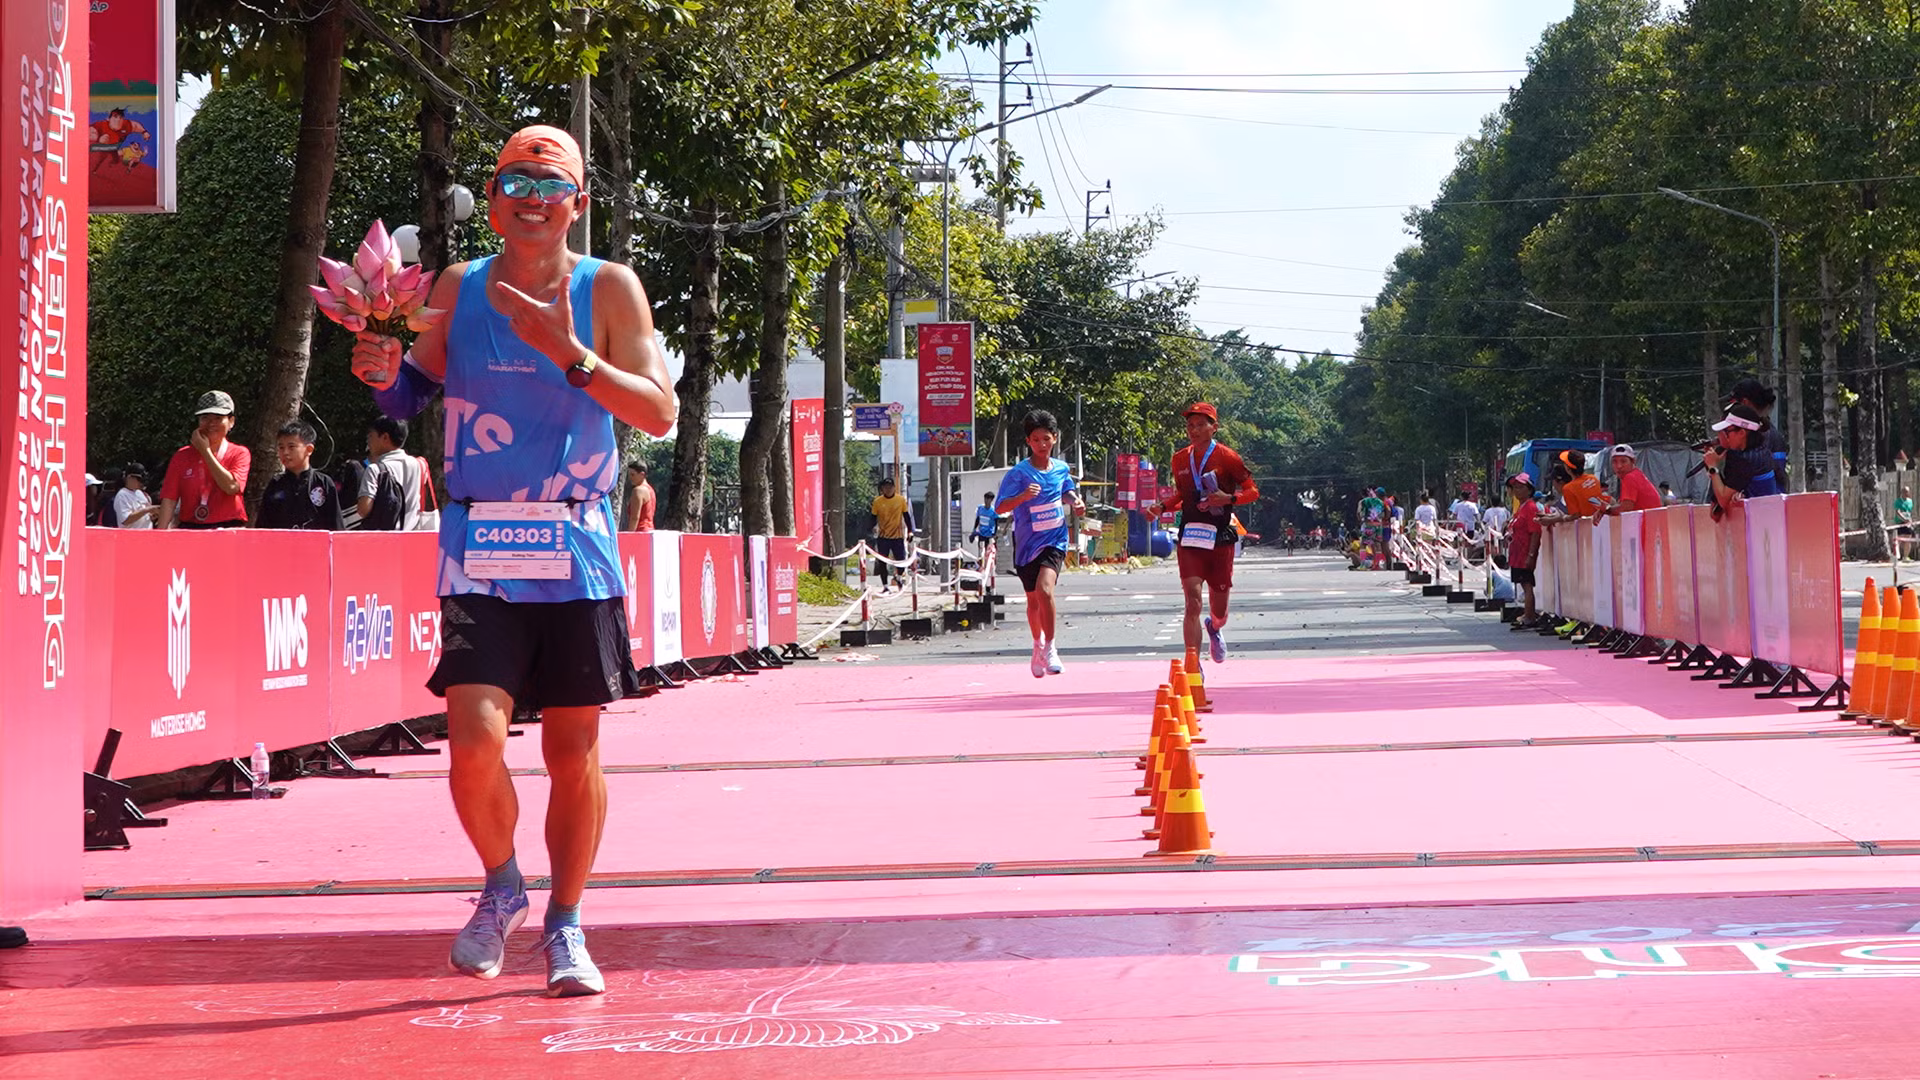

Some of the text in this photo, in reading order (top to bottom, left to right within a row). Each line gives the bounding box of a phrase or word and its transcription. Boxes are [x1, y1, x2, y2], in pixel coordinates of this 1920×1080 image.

[17, 53, 32, 597] CÚP MASTERISE HOMES
[30, 60, 45, 597] MARATHON 2024
[44, 195, 69, 379] SEN
[43, 395, 73, 690] HỒNG
[474, 527, 552, 544] C40303
[150, 710, 206, 739] MASTERISE HOMES
